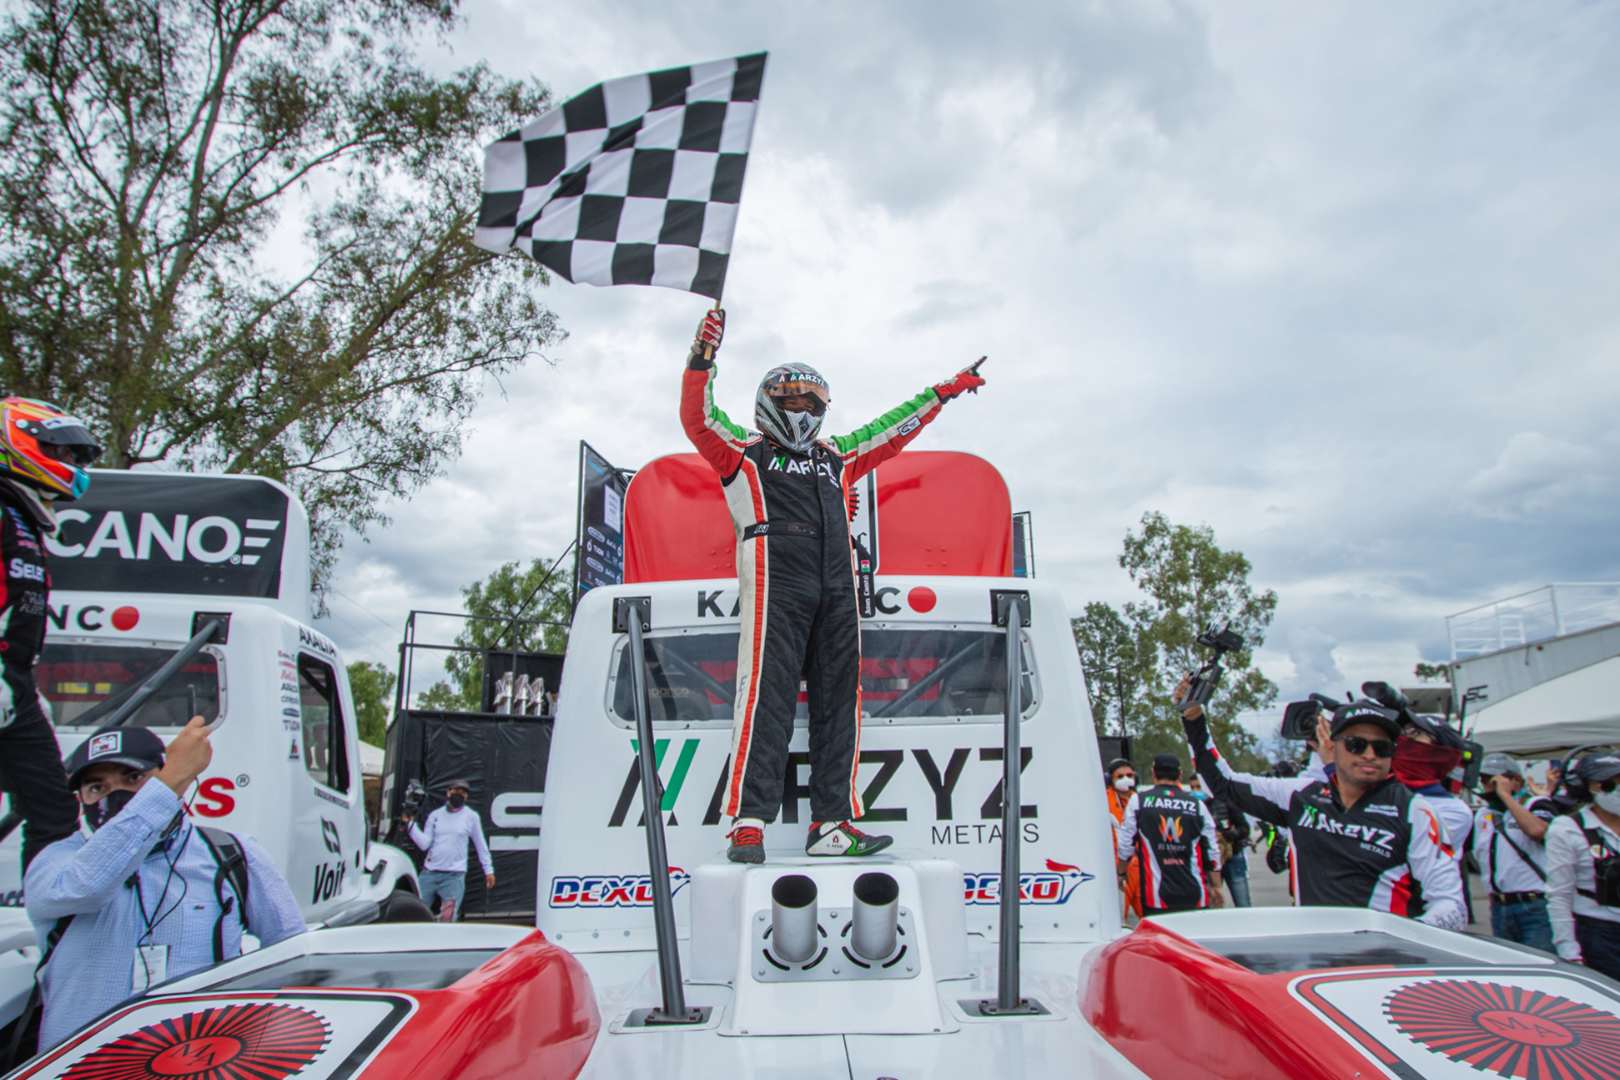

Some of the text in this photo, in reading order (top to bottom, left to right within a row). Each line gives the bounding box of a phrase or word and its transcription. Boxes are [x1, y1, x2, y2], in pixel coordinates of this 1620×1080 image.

[1155, 797, 1197, 812] ARZYZ
[931, 823, 1040, 846] METAS
[312, 861, 346, 906] Voit
